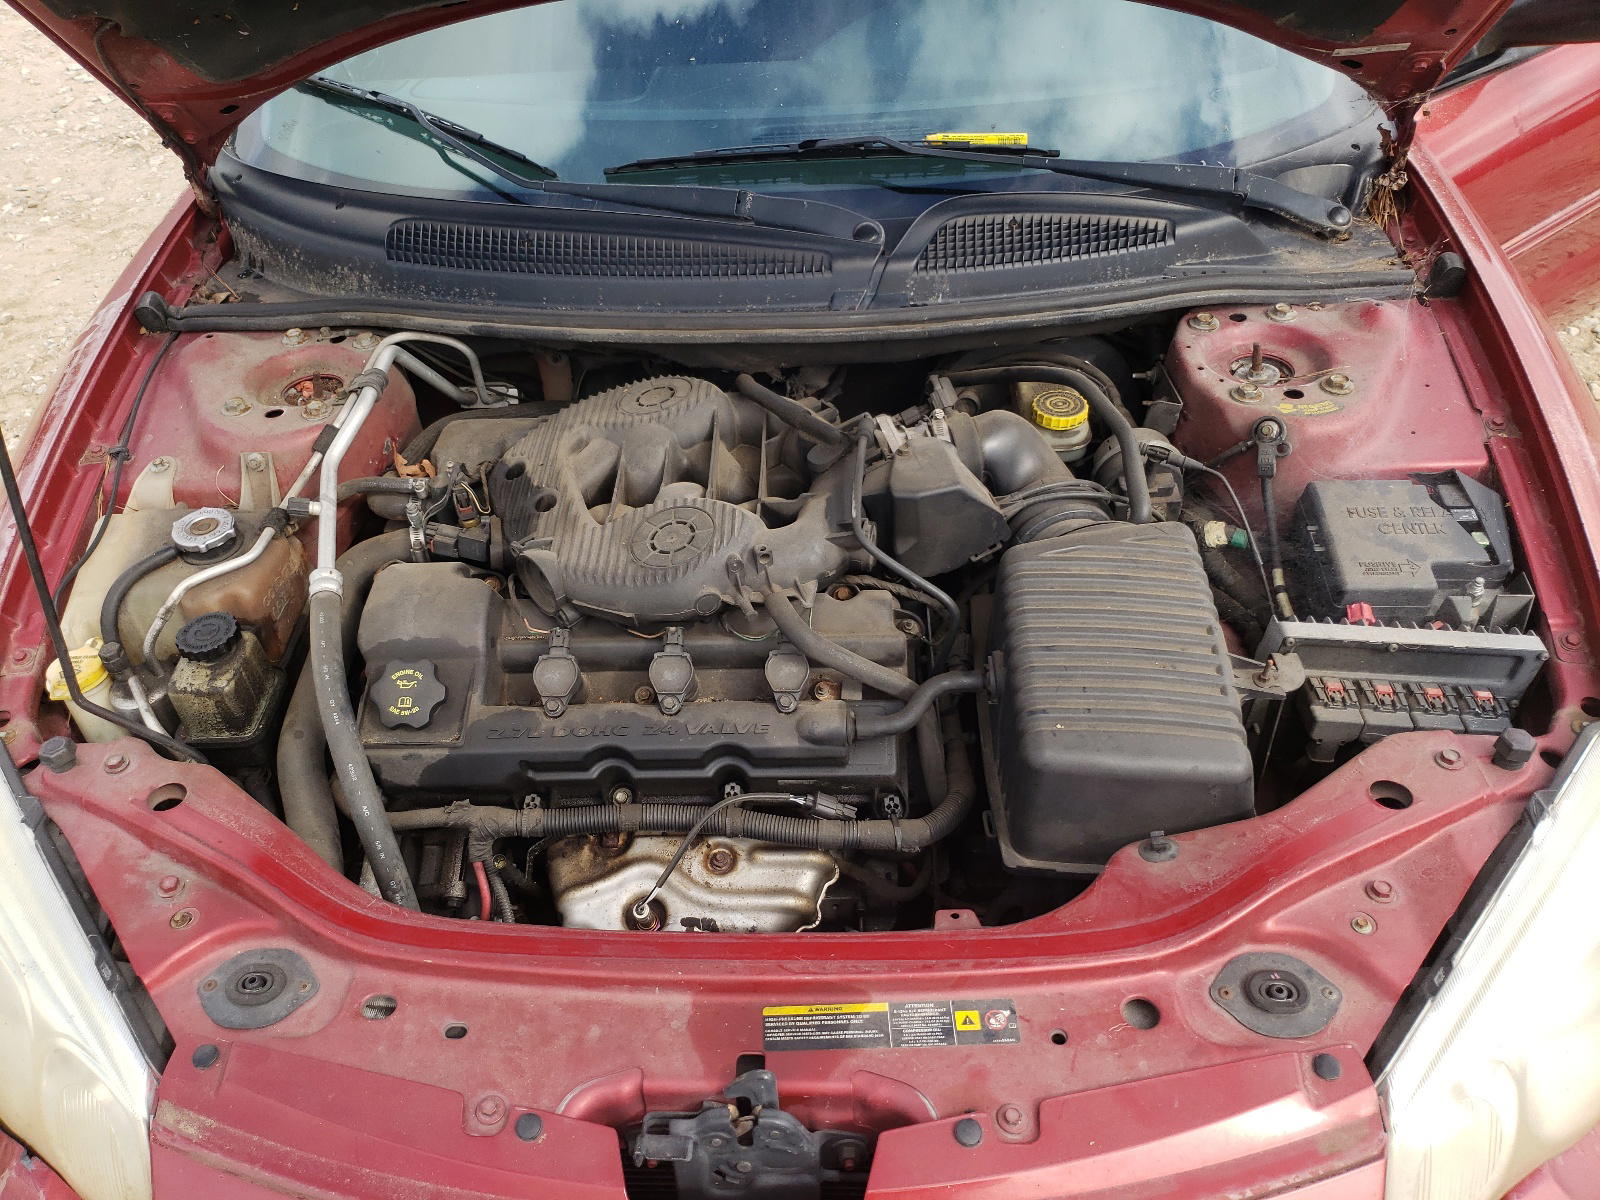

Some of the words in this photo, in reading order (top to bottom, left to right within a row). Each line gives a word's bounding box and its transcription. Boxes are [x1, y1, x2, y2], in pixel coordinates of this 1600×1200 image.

[1346, 506, 1388, 518] FUSE
[1393, 506, 1406, 518] &
[1377, 522, 1448, 535] CENTER
[391, 669, 415, 680] ENGINE
[414, 671, 424, 680] OIL
[551, 726, 630, 738] DOHC
[685, 722, 771, 736] VALVE
